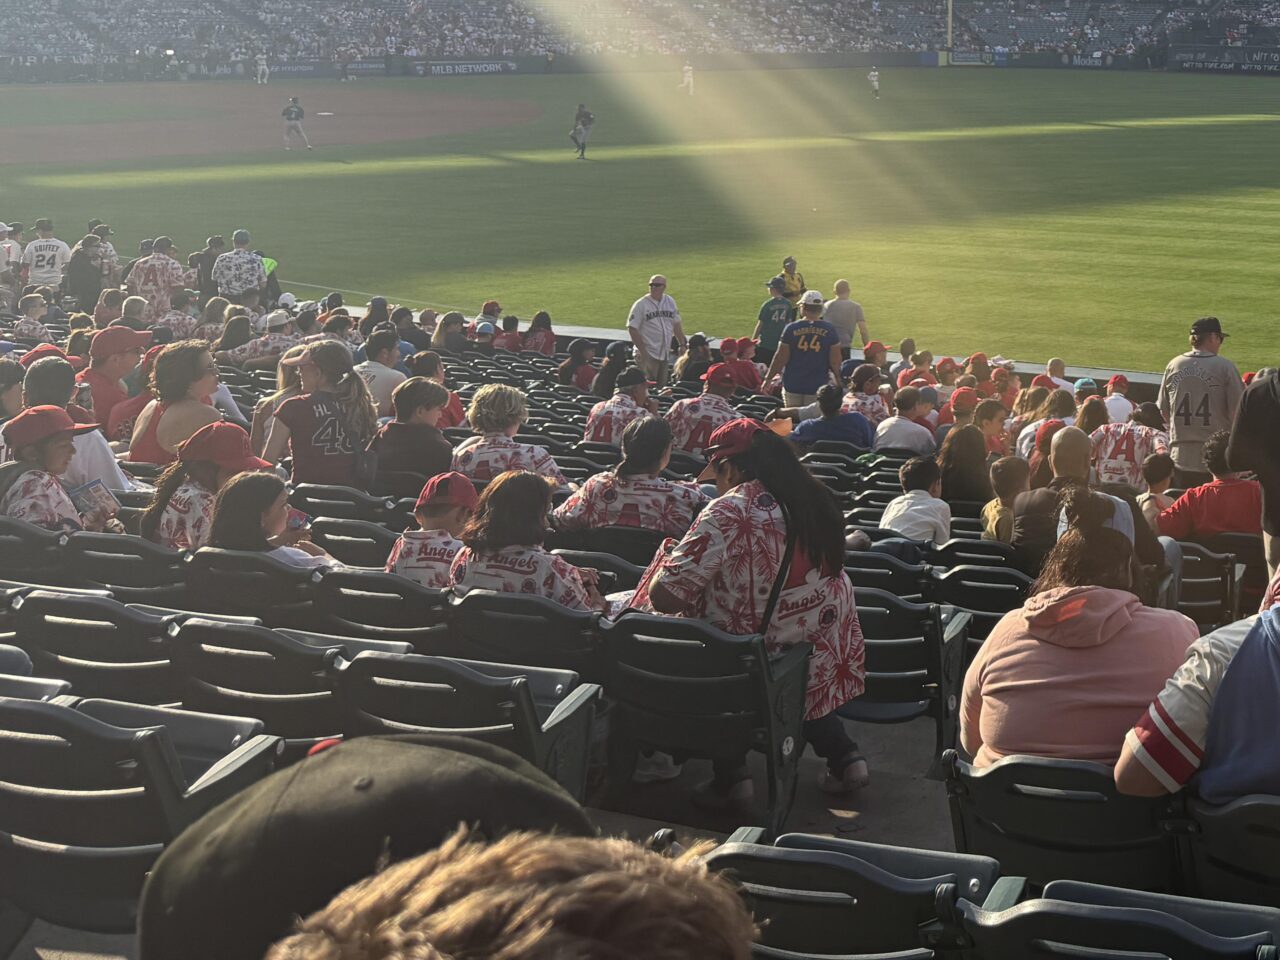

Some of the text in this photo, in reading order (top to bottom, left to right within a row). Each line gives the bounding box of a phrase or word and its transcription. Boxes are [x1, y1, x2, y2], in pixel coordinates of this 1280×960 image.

[431, 62, 503, 75] MLB NETWORK
[35, 254, 56, 269] 24
[771, 309, 787, 323] 44
[796, 339, 822, 353] 44
[1175, 392, 1212, 427] 44
[1108, 428, 1136, 462] A
[487, 553, 539, 574] Angels
[778, 589, 827, 617] Angels
